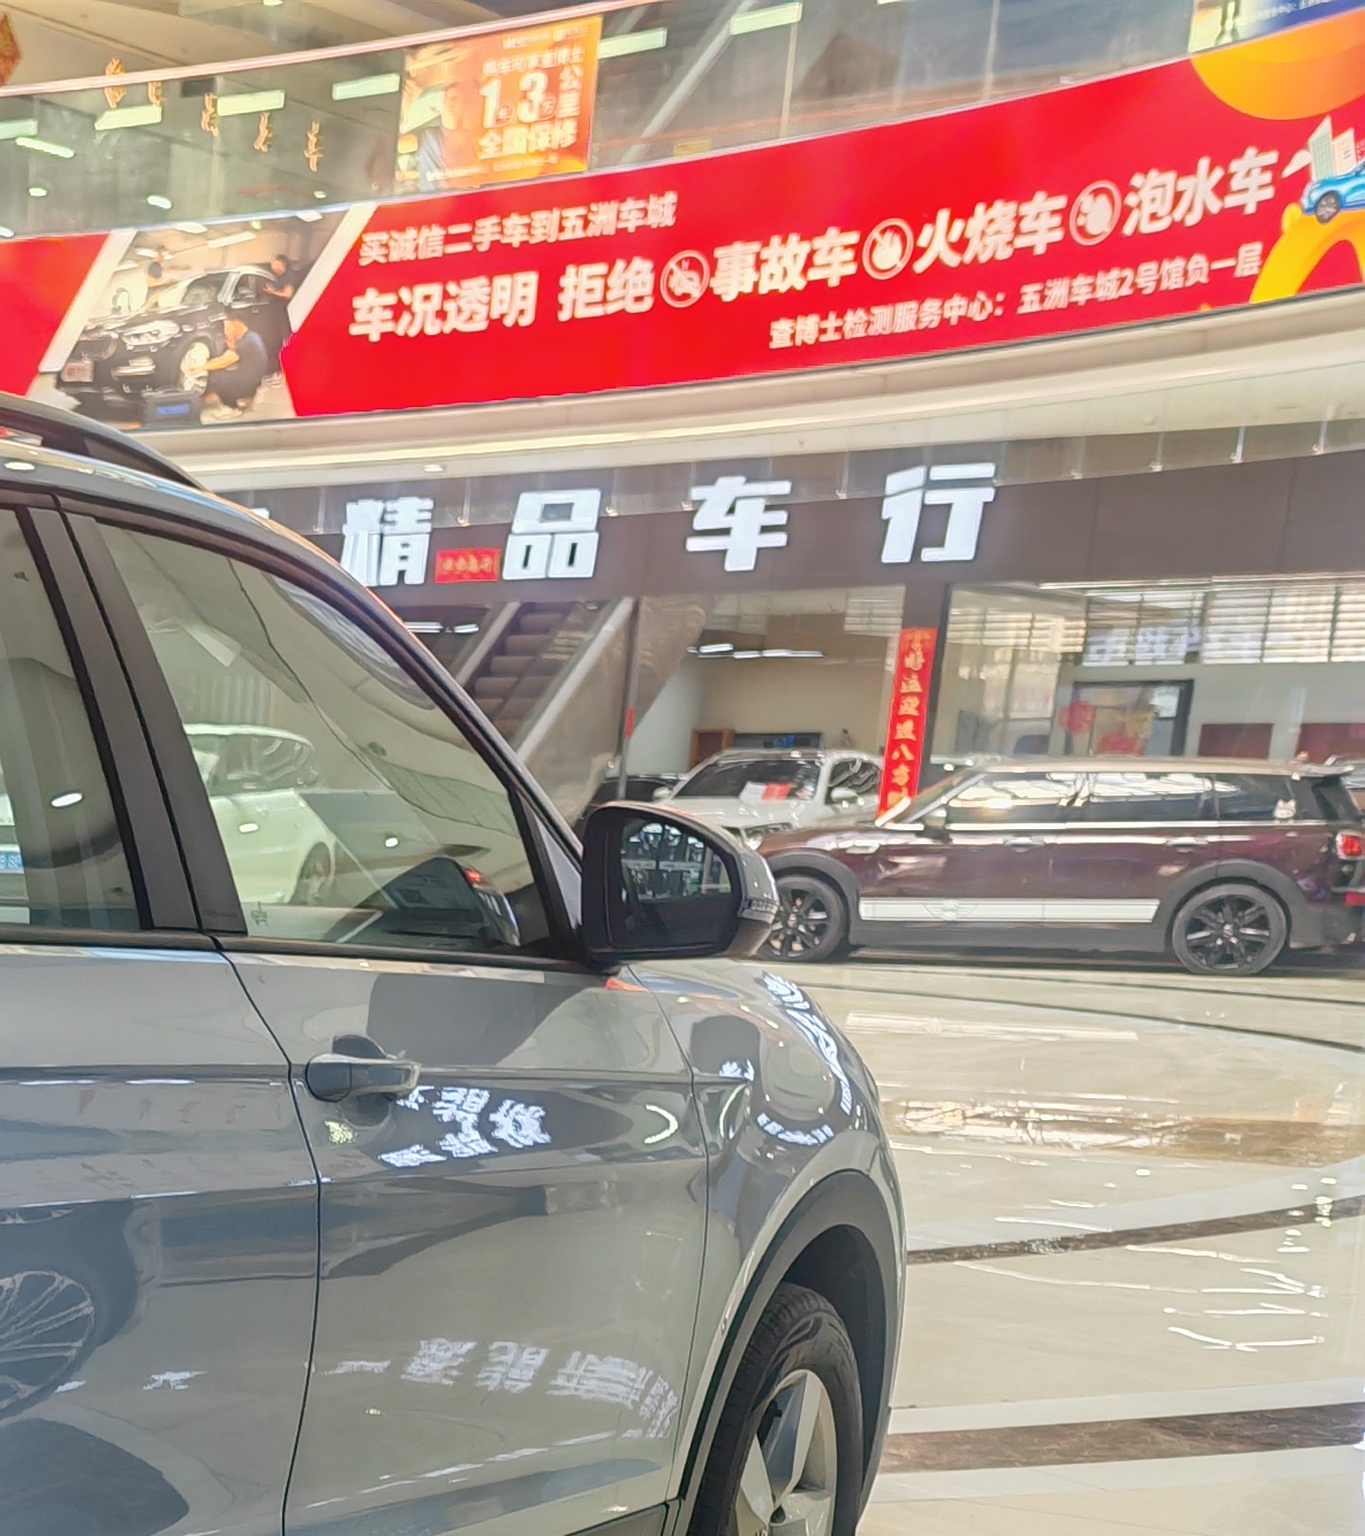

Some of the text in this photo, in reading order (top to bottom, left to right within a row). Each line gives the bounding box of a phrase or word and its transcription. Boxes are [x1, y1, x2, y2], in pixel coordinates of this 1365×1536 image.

[348, 145, 1279, 343] 车况透明 拒绝 事故车 火烧车 泡水车
[358, 191, 679, 267] 买诚信二手车到五洲车城
